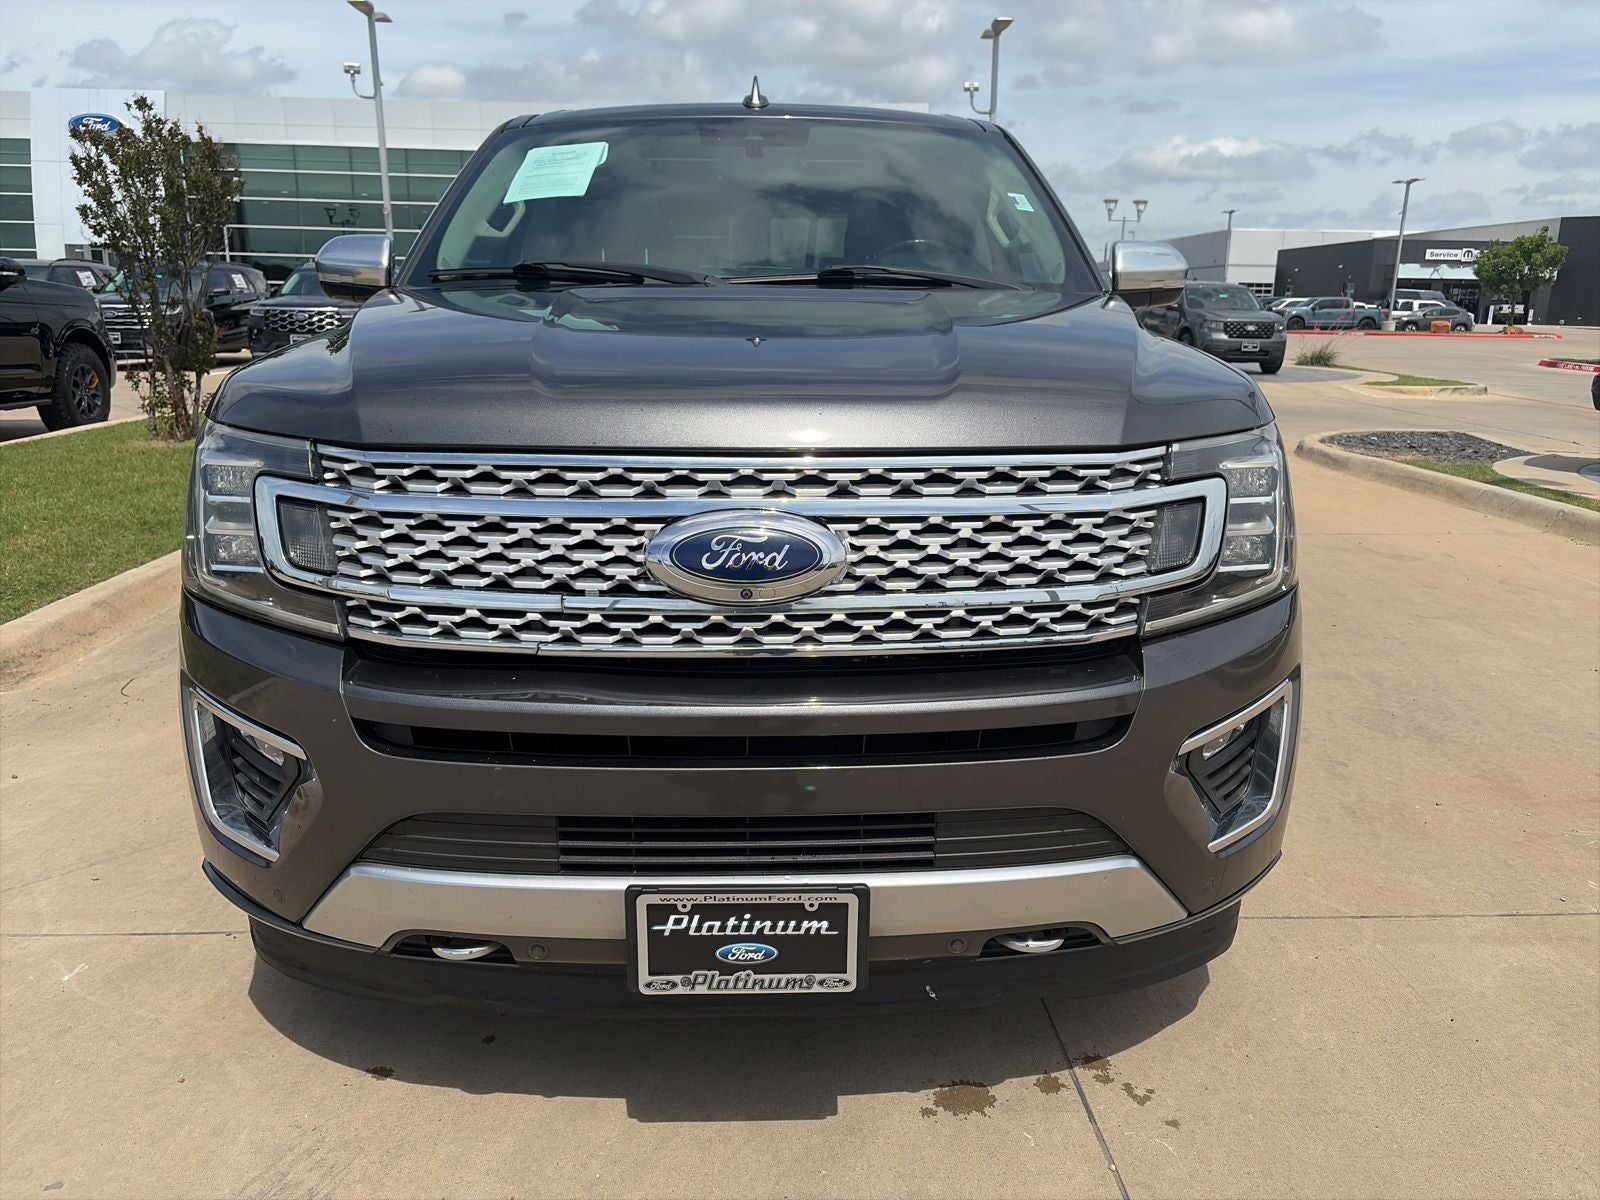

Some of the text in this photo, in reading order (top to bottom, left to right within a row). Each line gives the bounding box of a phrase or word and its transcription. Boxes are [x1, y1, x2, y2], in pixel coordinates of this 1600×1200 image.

[701, 535, 790, 571] Ford
[659, 895, 837, 903] www.PlatinumFord.com
[651, 913, 839, 936] Platinum
[728, 946, 765, 960] Ford
[649, 981, 673, 990] Ford
[690, 970, 810, 991] Platinum
[822, 979, 846, 988] Ford
